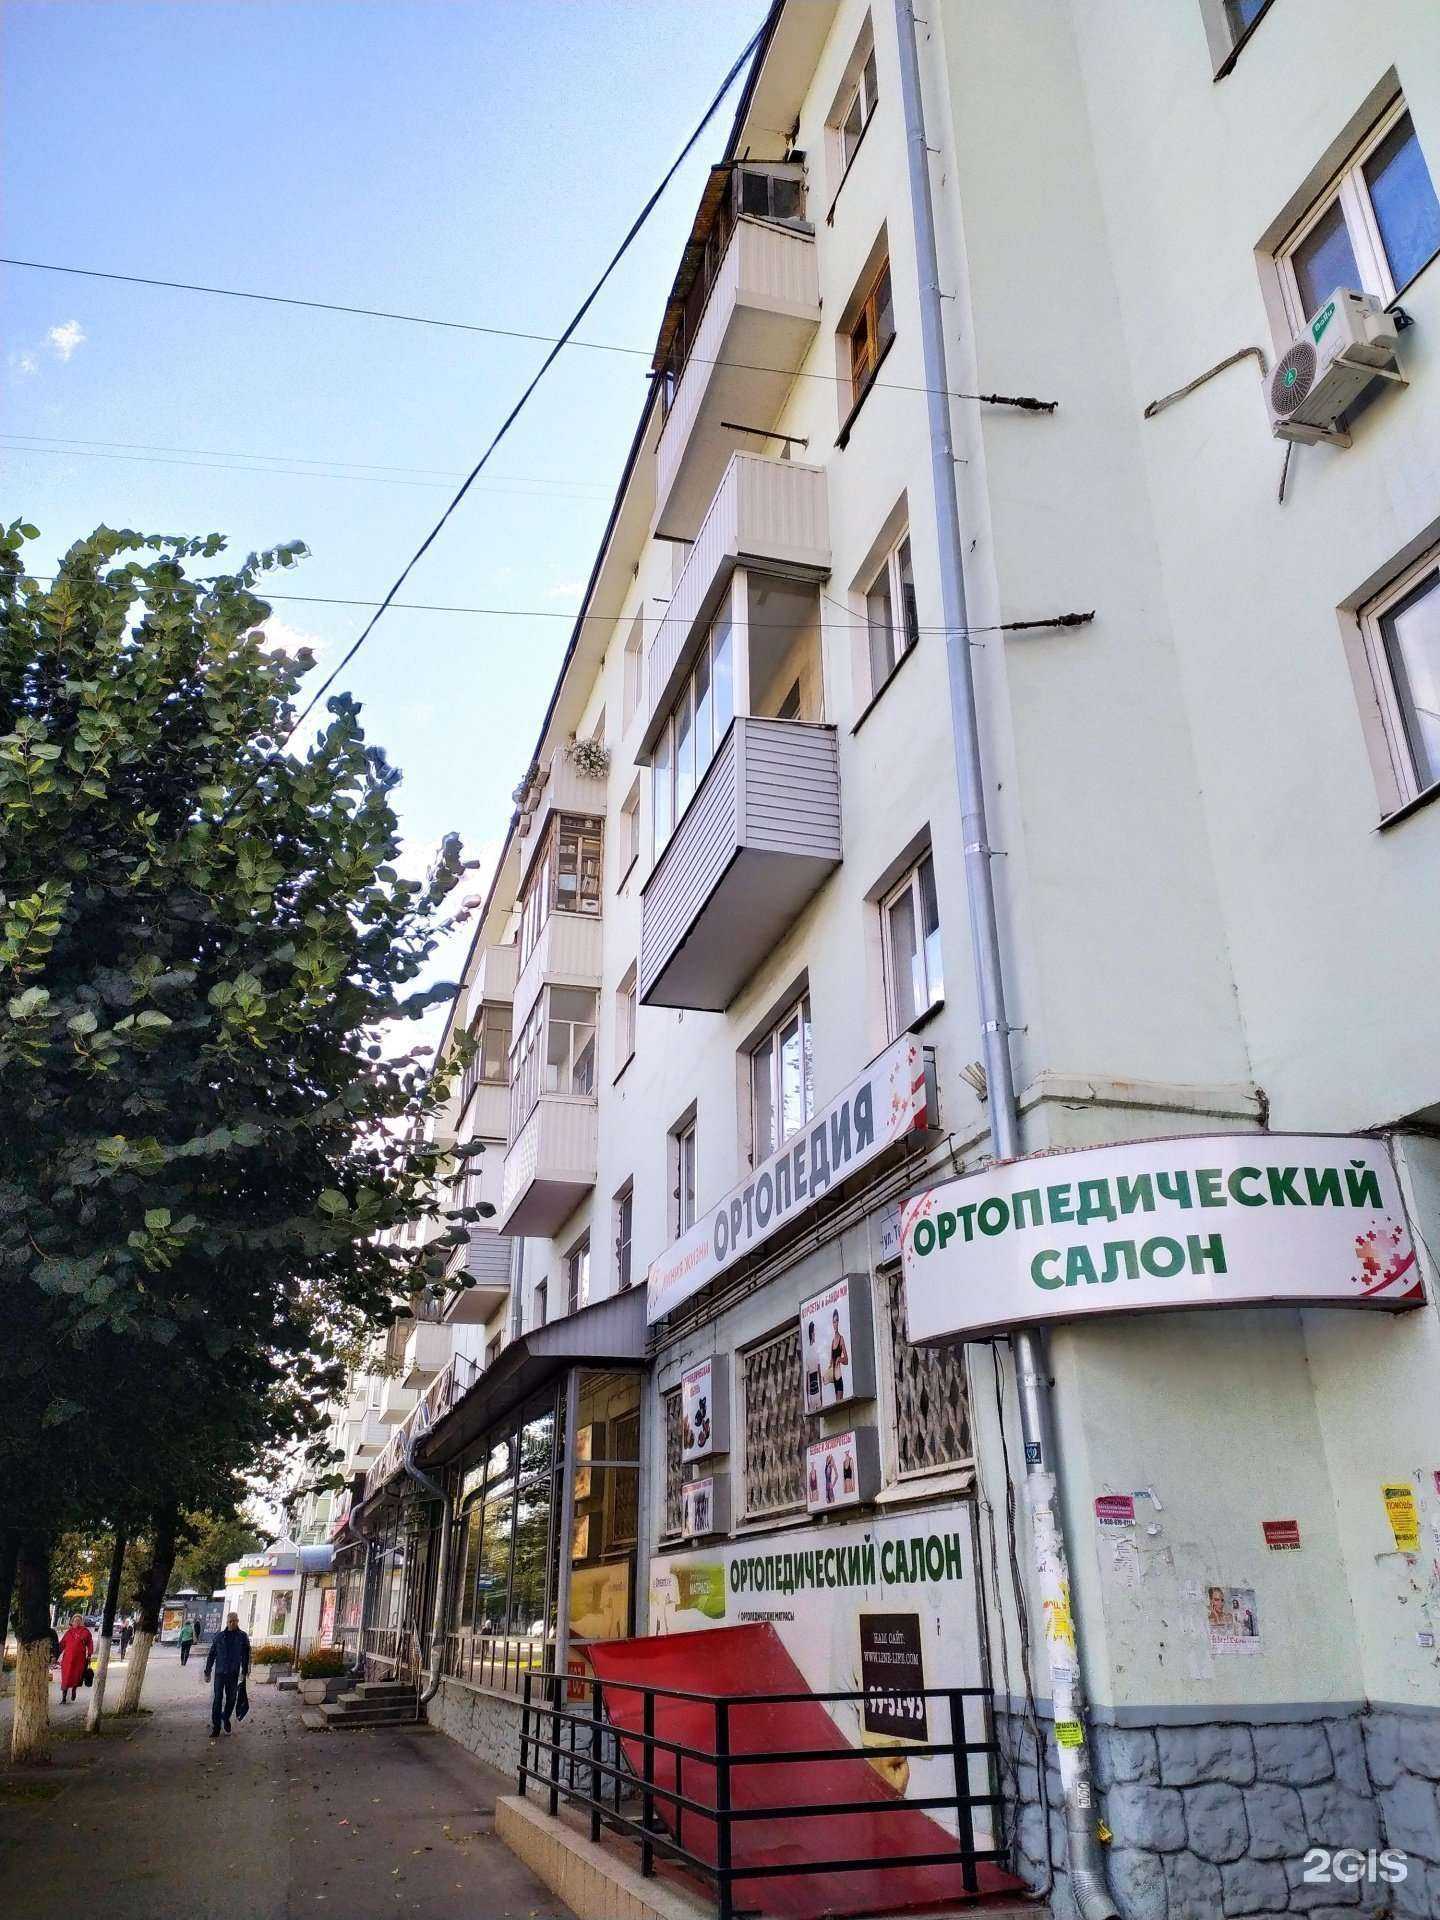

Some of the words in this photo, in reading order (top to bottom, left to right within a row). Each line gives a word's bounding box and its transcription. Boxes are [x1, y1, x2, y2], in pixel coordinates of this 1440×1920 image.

[714, 1081, 874, 1262] ОРТОПЕДИЯ
[913, 1160, 1385, 1257] ОРТОПЕДИЧЕСКИЙ
[1030, 1233, 1228, 1290] САЛОН
[730, 1534, 876, 1595] ОРТОПЕДИЧЕСКИЙ
[881, 1533, 963, 1584] САЛОН
